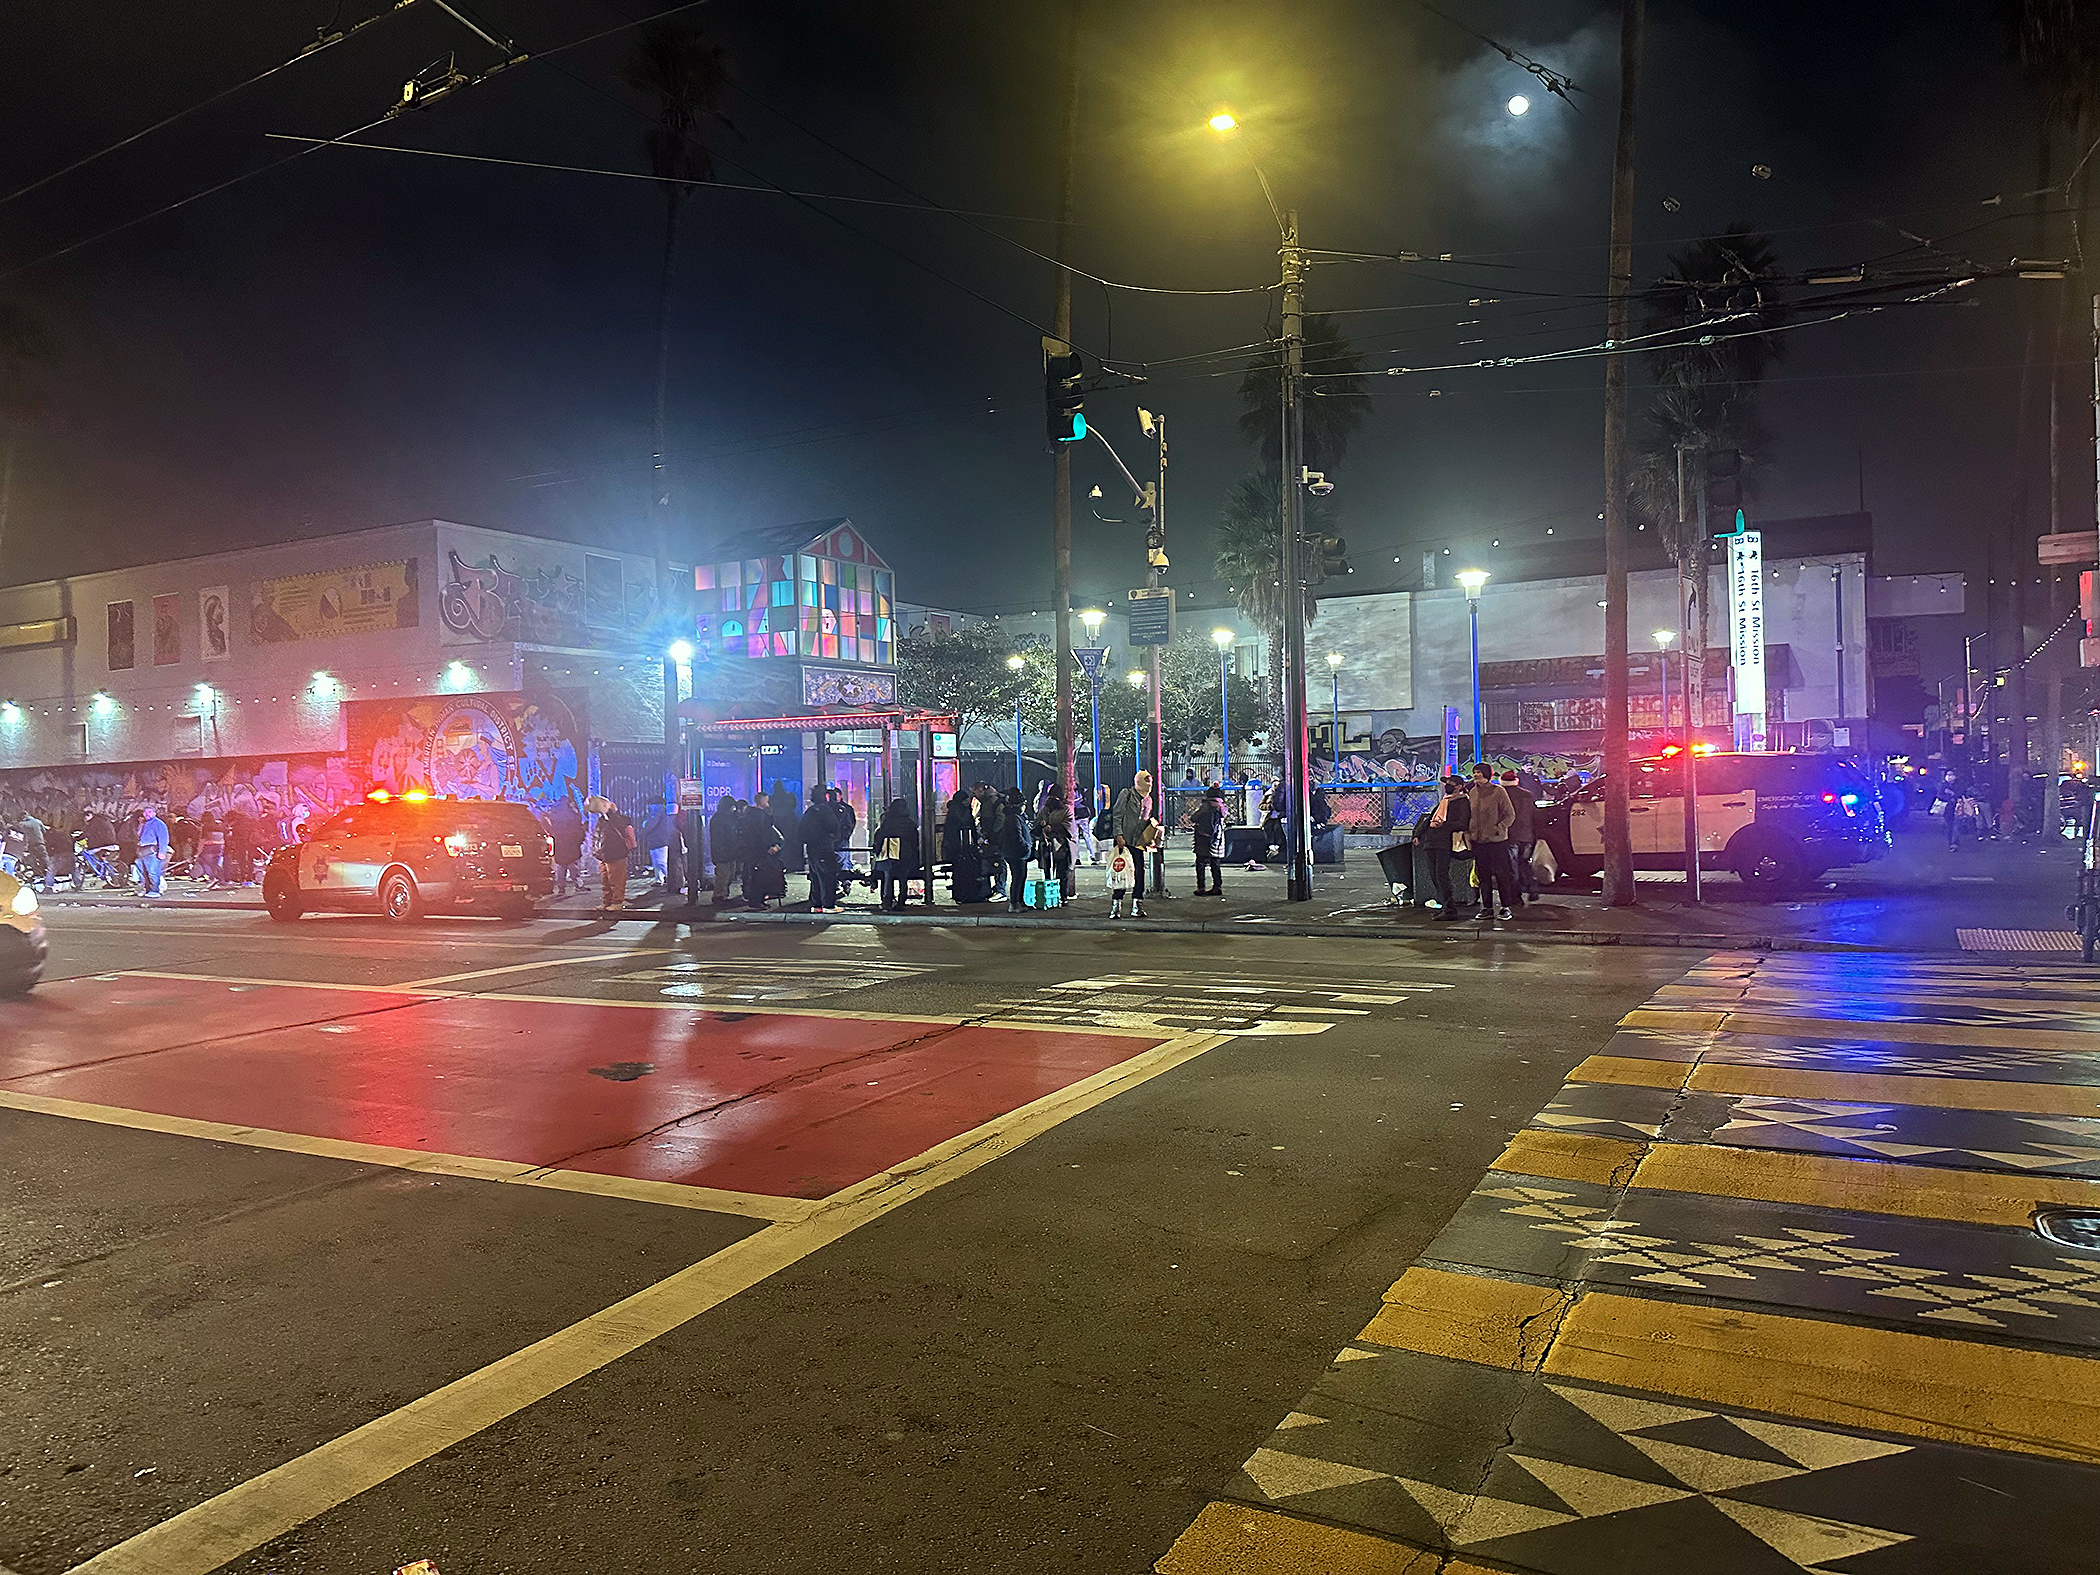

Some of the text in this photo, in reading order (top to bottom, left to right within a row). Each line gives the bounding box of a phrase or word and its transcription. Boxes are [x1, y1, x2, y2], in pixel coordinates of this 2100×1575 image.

[1737, 569, 1747, 666] 16th St Mission
[1751, 569, 1761, 665] 16th St Mission
[434, 704, 455, 728] INDIAN
[456, 698, 489, 713] CULTURAL
[490, 710, 513, 750] DISTRICT
[707, 787, 731, 797] GDPR
